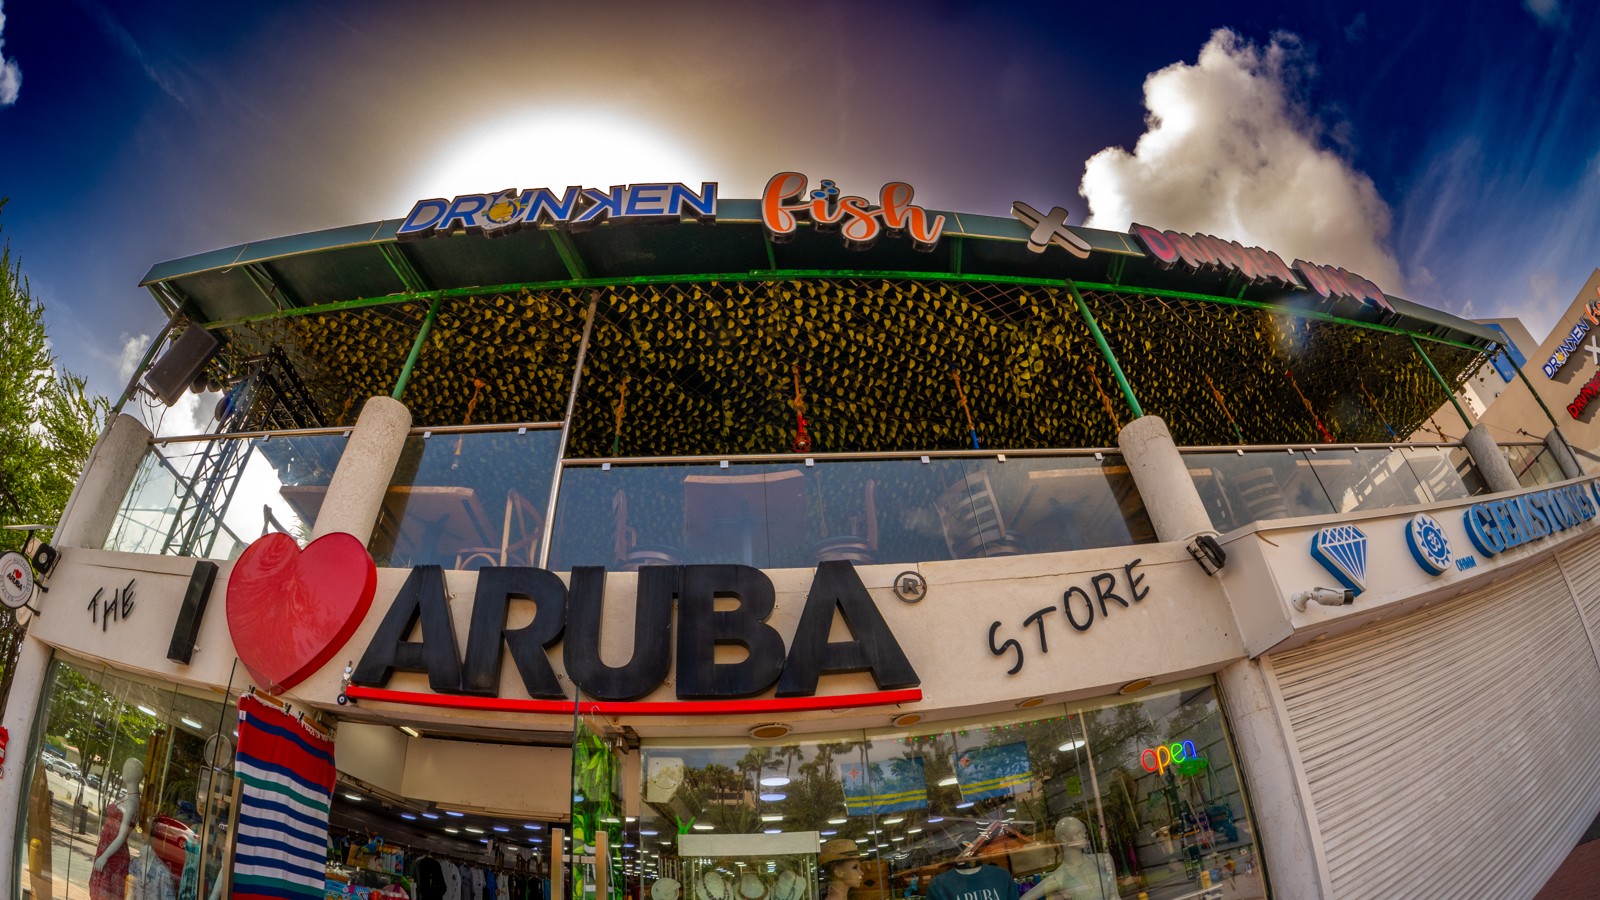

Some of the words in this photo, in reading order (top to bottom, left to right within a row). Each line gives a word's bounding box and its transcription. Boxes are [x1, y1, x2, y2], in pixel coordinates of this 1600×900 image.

[397, 182, 718, 236] DRUNKEN
[762, 171, 945, 250] fish
[1542, 316, 1590, 379] DRUNKEN
[1464, 483, 1597, 558] GEMSTONES
[6, 572, 23, 591] ARUBA
[1455, 555, 1477, 572] OHMM
[87, 577, 138, 632] THE
[351, 560, 922, 702] ARUBA
[986, 558, 1151, 676] STORE
[1140, 738, 1197, 776] open
